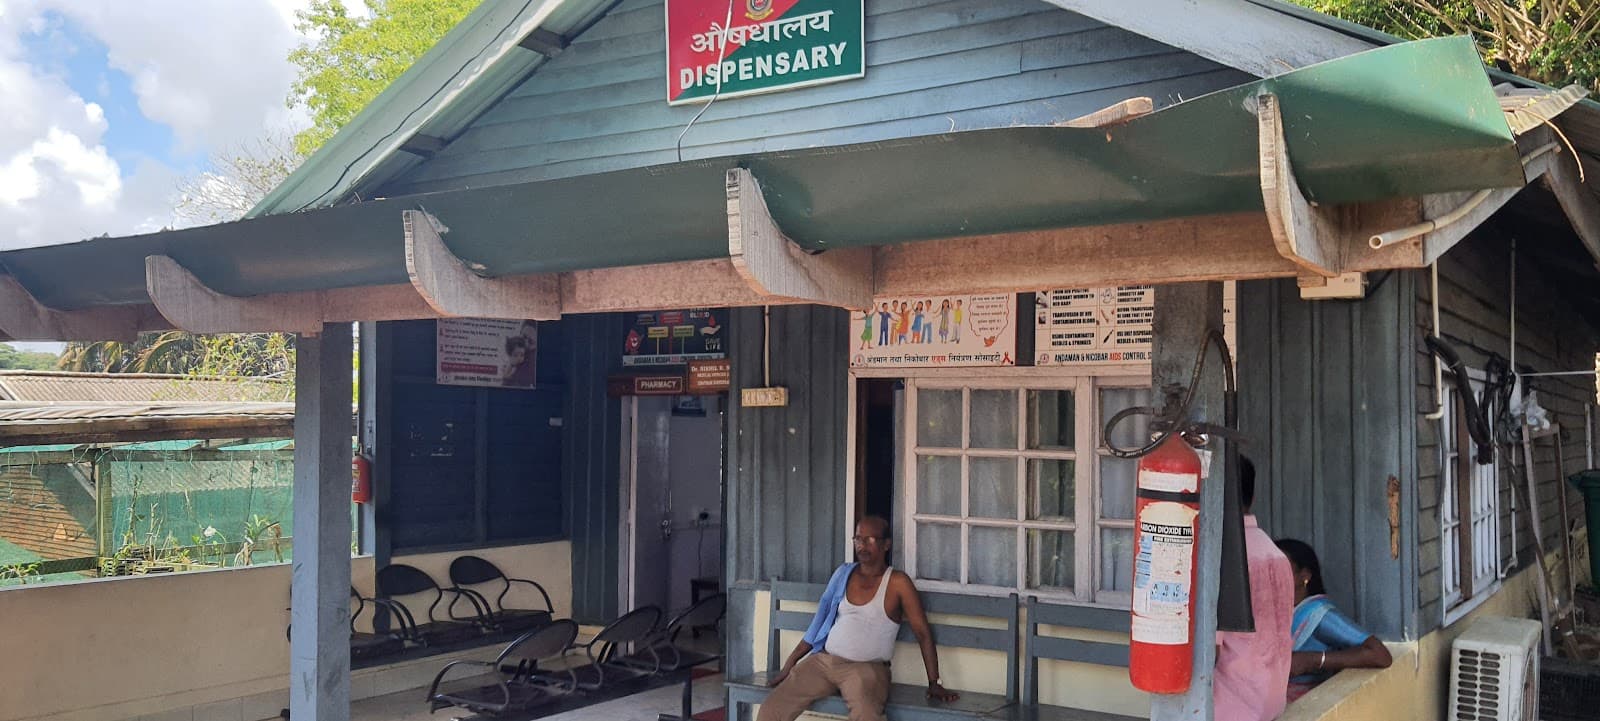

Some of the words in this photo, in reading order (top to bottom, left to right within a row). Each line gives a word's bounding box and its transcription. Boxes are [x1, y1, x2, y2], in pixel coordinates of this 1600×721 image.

[690, 10, 834, 52] औषधालय
[680, 42, 847, 90] DISPENSARY
[1055, 353, 1080, 363] ANDAMAN
[1080, 353, 1085, 362] &
[1085, 352, 1108, 362] NICOBAR
[1109, 352, 1122, 361] AIDS
[1122, 351, 1146, 361] CONTROL
[640, 380, 677, 390] PHARMACY
[1157, 525, 1182, 535] DIOXIDE
